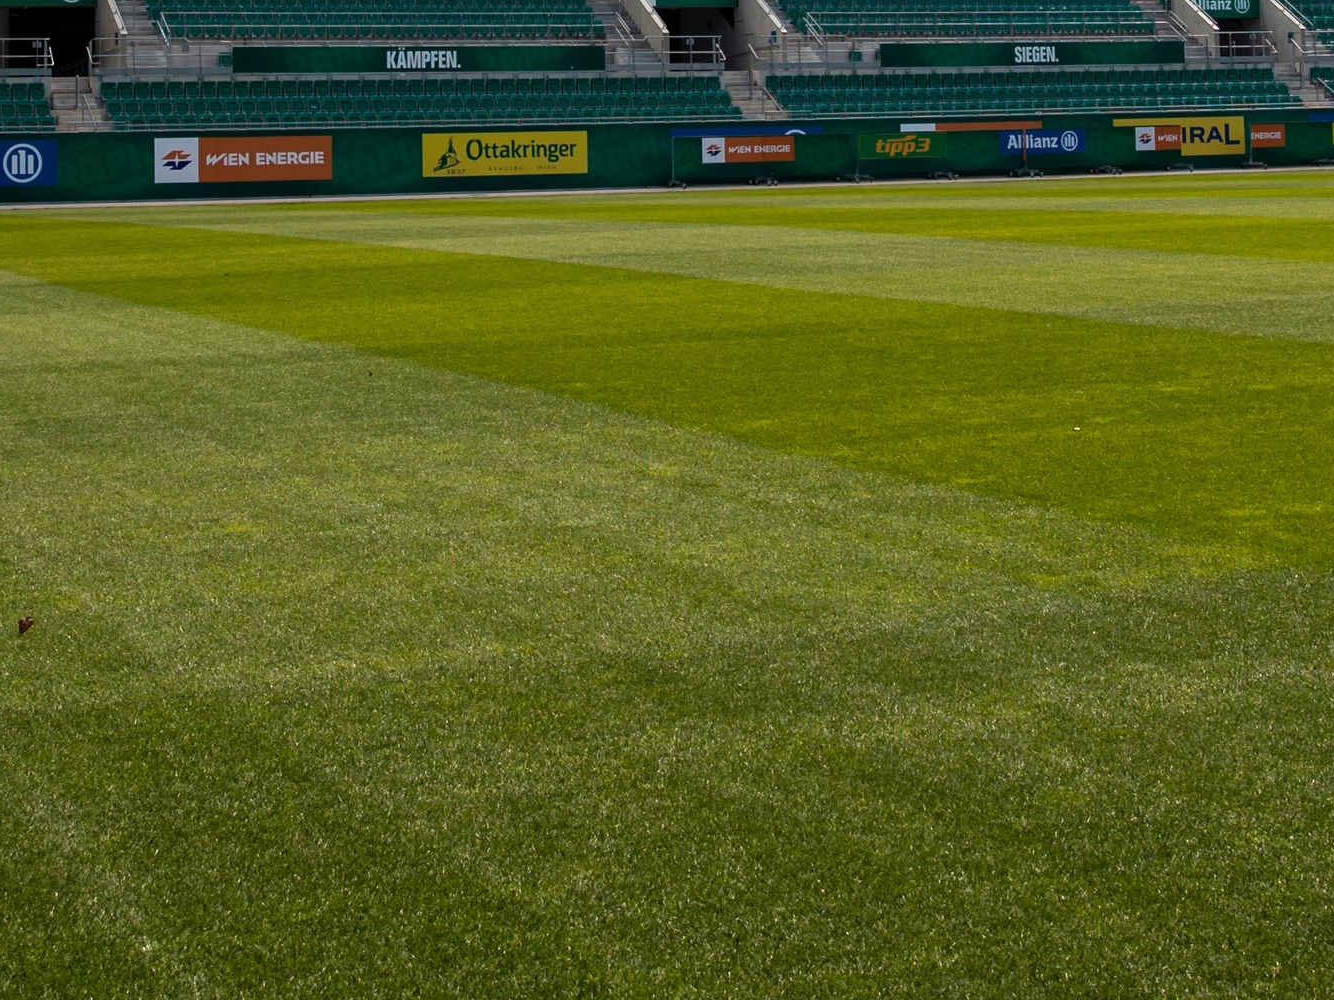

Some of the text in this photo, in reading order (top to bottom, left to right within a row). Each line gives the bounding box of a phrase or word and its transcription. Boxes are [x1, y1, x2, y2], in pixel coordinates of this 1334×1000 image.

[386, 46, 462, 69] KÄMPFEN.
[1014, 46, 1059, 63] SIEGEN.
[1006, 133, 1059, 150] Allianz
[1157, 131, 1178, 141] WIEN
[1181, 123, 1241, 146] IRAL
[465, 138, 577, 162] Ottakringer
[727, 143, 792, 155] WIEN ENERGIE
[875, 134, 931, 157] tipp3
[205, 150, 325, 167] WIEN ENERGIE
